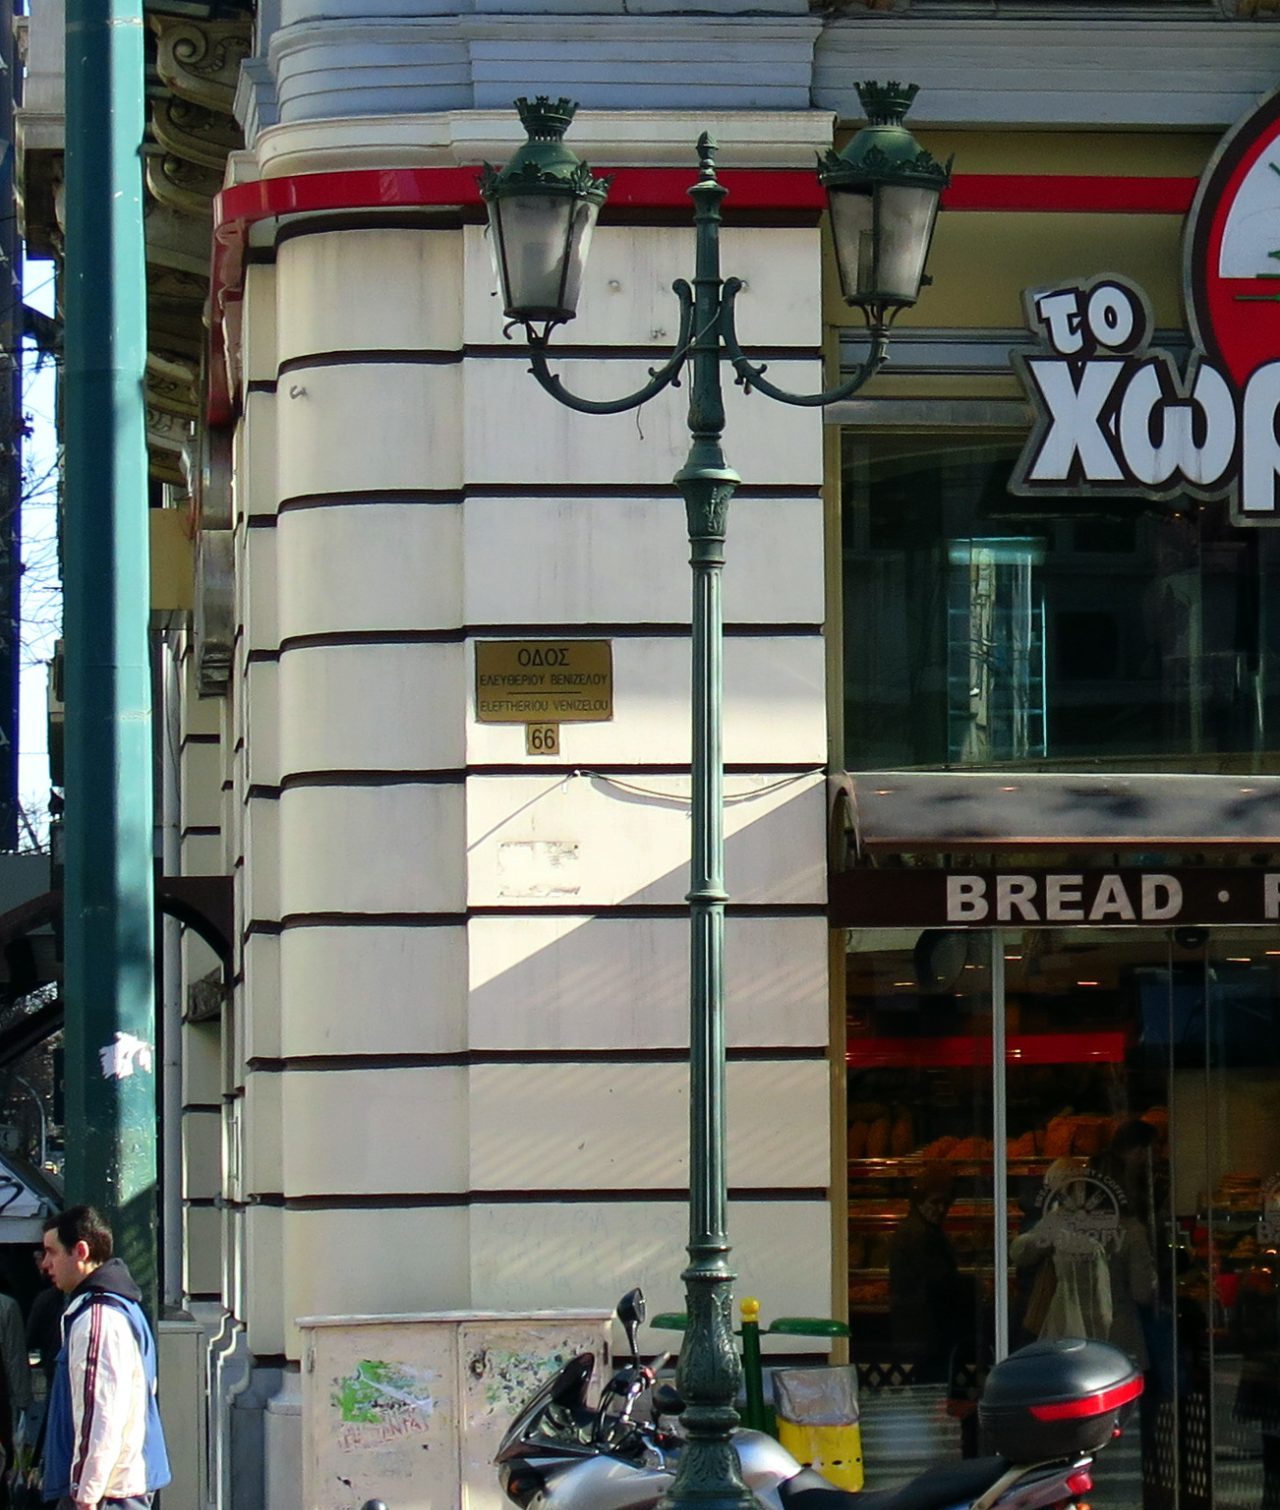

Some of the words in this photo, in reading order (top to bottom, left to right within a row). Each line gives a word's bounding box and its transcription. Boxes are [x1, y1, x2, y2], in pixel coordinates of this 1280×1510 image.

[517, 648, 570, 667] ΟΔΟΣ
[480, 674, 545, 687] ΕΛΕΥΘΕΡΙΟΥ
[550, 674, 608, 686] ΒΕΝΙΖΕΛΟΥ
[480, 700, 548, 712] ELEFTHERIOU
[553, 700, 608, 712] VENIZELOU
[531, 728, 555, 749] 66
[946, 874, 1183, 922] BREAD
